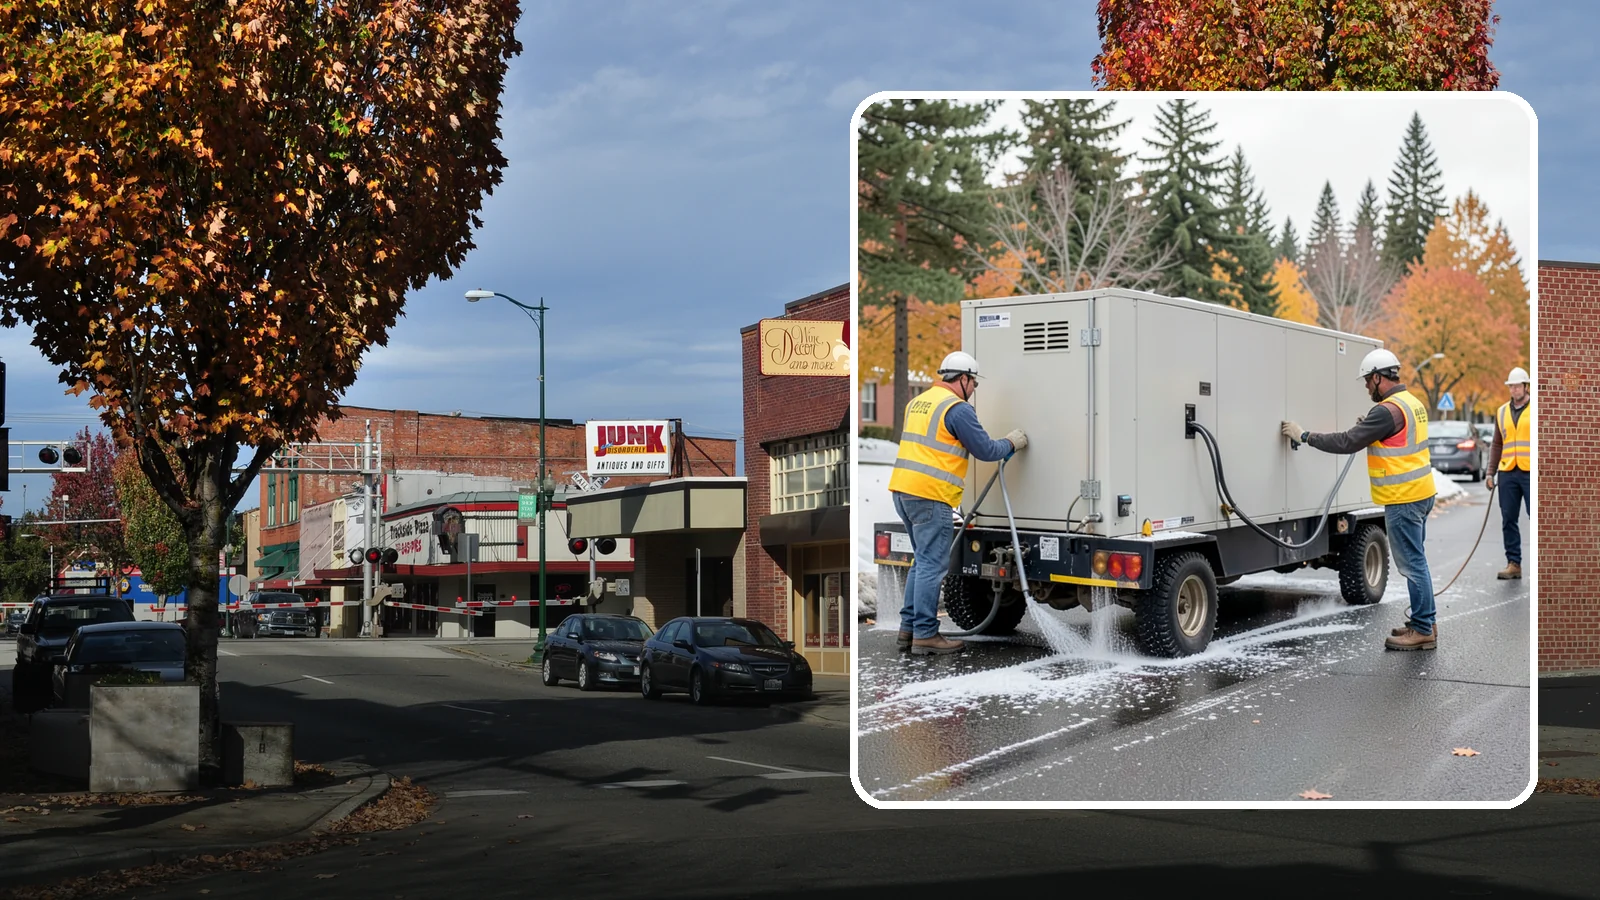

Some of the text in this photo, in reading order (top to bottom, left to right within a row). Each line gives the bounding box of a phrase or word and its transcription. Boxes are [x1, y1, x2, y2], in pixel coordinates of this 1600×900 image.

[596, 425, 665, 457] JUNK
[607, 446, 646, 454] DISORDERLY
[597, 460, 665, 470] ANTIQUES AND GIFTS
[390, 519, 429, 539] Trackside Pizza
